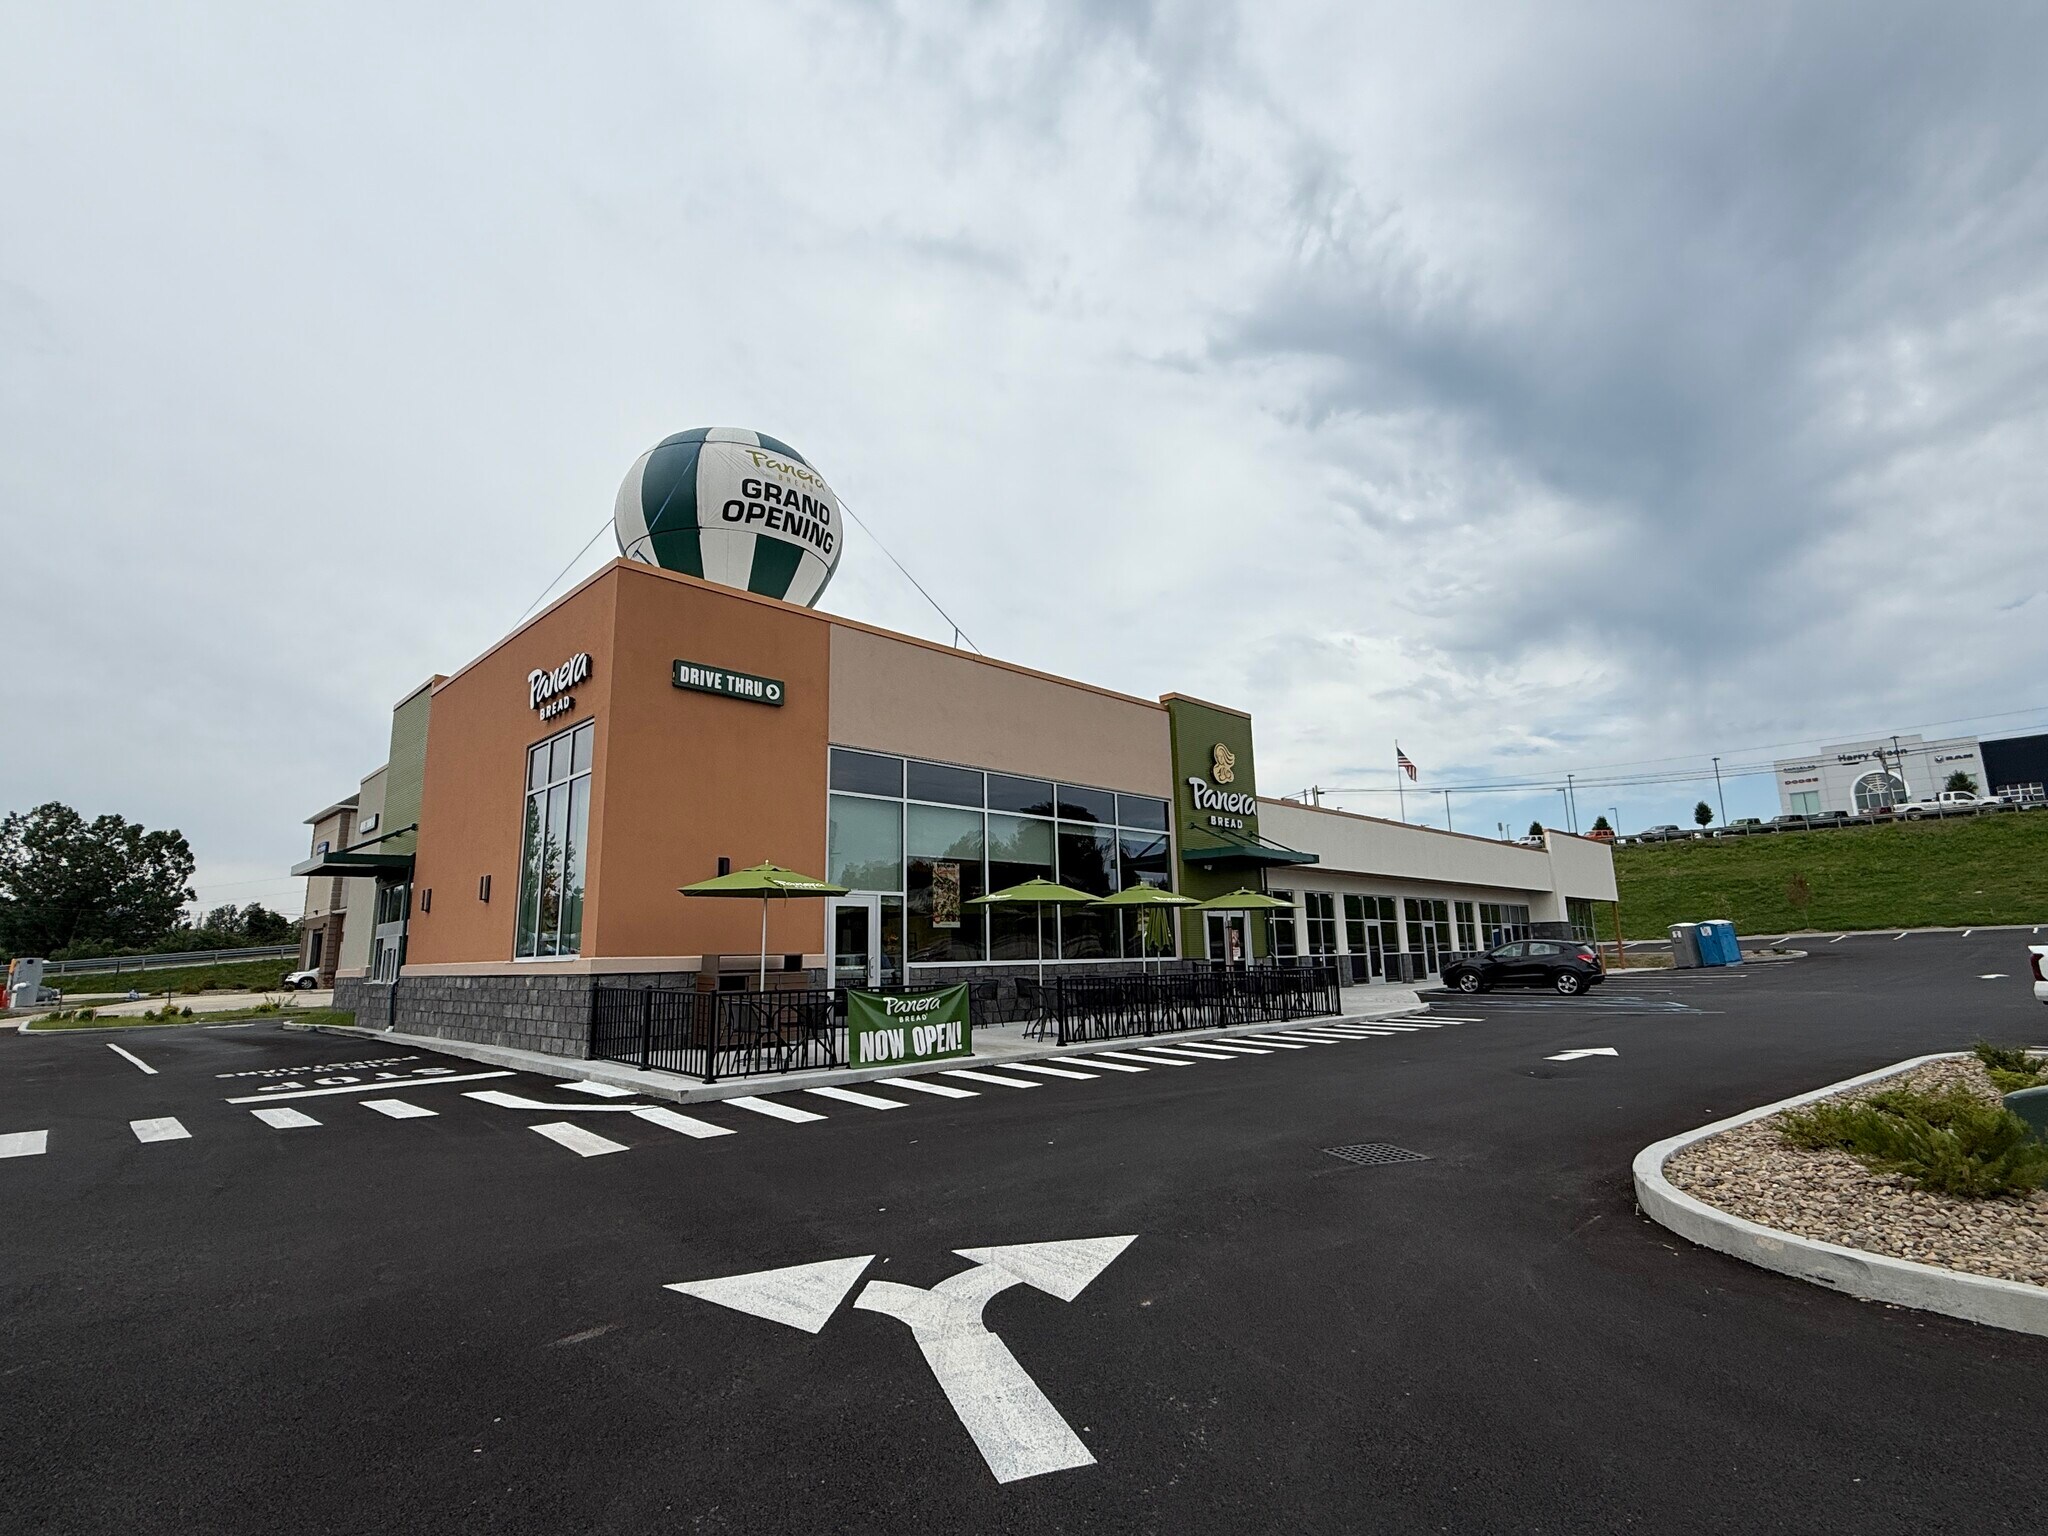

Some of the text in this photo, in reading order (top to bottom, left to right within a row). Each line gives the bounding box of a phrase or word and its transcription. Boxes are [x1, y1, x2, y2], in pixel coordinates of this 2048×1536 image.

[745, 449, 826, 493] Panera
[741, 478, 830, 526] GRAND
[722, 500, 834, 555] OPENING
[527, 652, 590, 710] Panera
[680, 665, 763, 698] DRIVE THRU
[540, 696, 571, 721] BREAD
[1188, 776, 1257, 816] Panera
[1210, 815, 1243, 829] BREAD
[882, 996, 941, 1016] Panera
[899, 1014, 927, 1023] BREAD
[860, 1020, 963, 1063] NOW OPEN!
[257, 1067, 457, 1092] STOP
